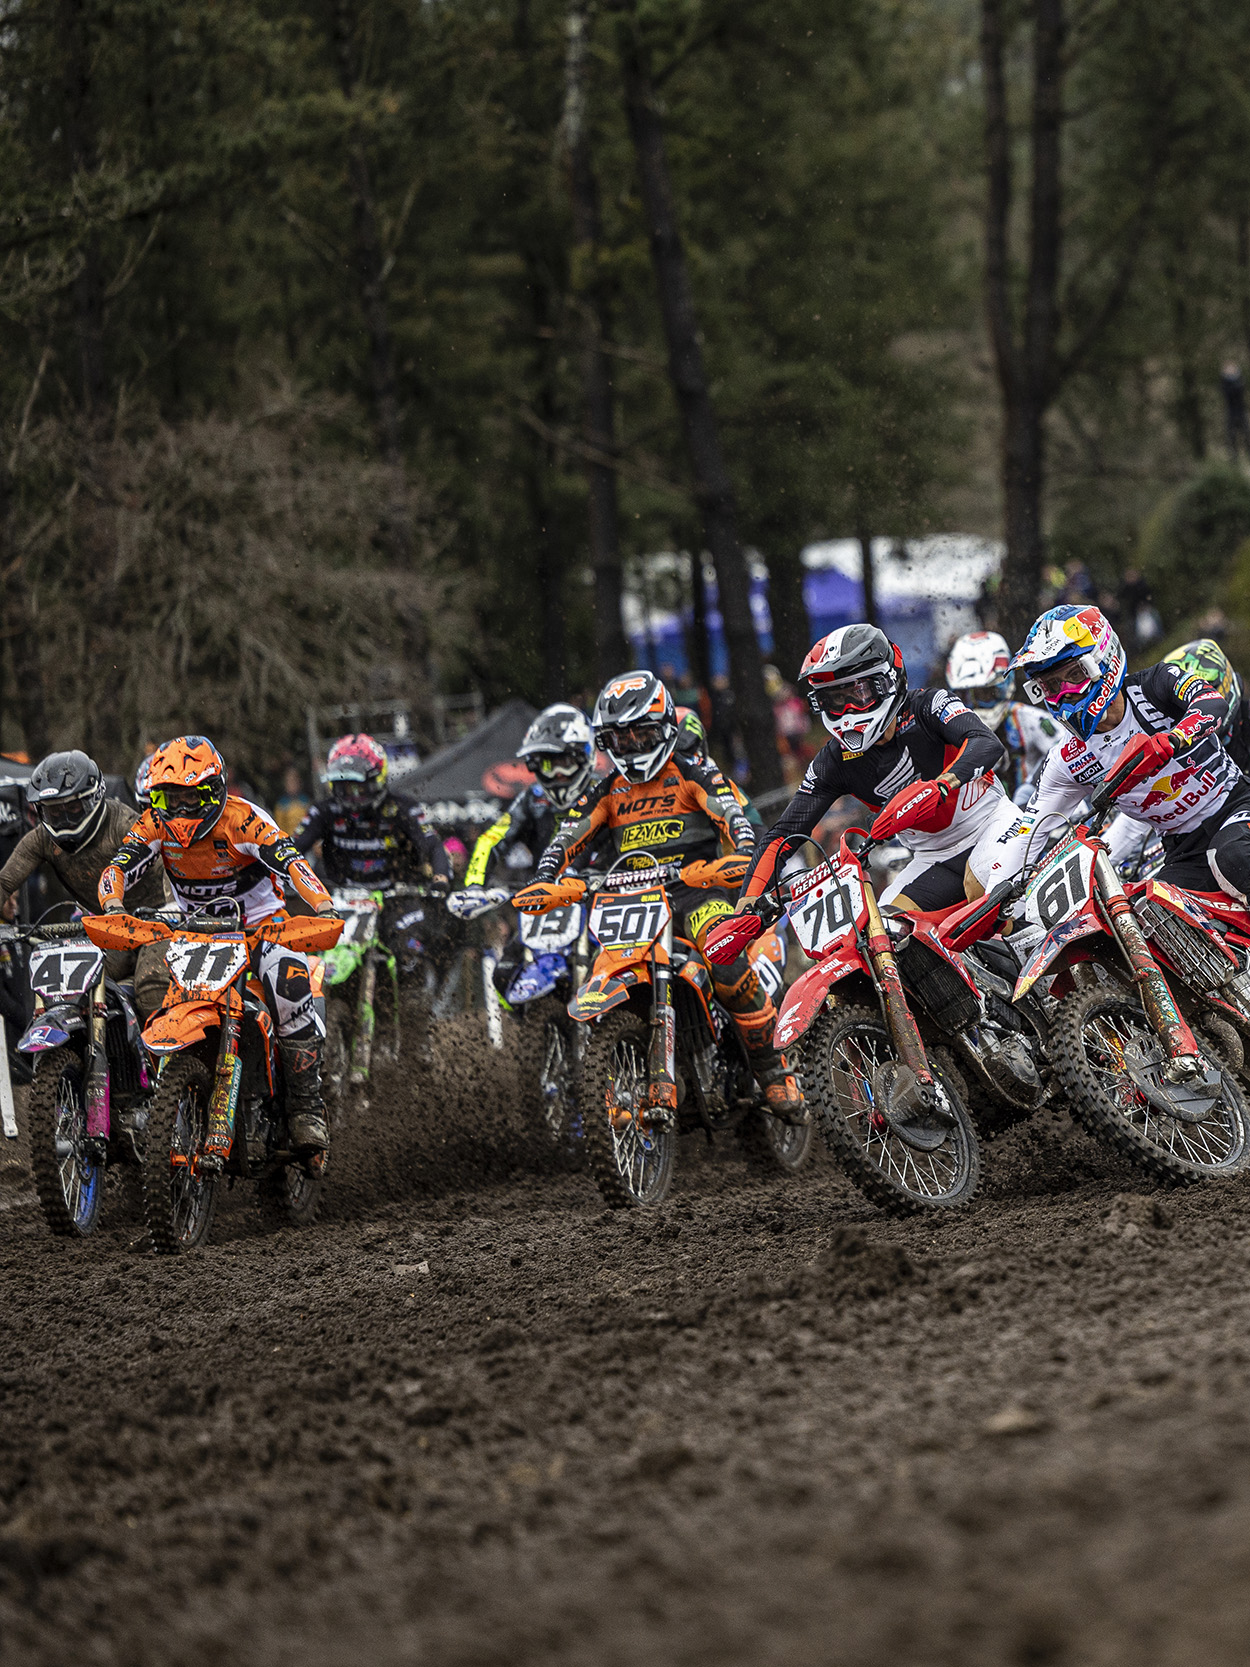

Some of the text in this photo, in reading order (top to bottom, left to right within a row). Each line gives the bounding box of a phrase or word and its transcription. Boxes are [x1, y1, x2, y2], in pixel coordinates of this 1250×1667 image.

[1087, 683, 1112, 717] Red
[1106, 655, 1122, 686] Bull
[617, 794, 676, 816] MOTS
[895, 788, 933, 820] ACERBIS
[1149, 771, 1217, 825] Red Bull
[175, 880, 238, 897] MOTS
[606, 870, 668, 887] RENTHAL
[1036, 852, 1088, 931] 61
[597, 904, 663, 943] 501
[803, 883, 852, 953] 70
[182, 944, 236, 981] 11
[706, 935, 735, 957] ACERBIS
[31, 951, 99, 992] 47
